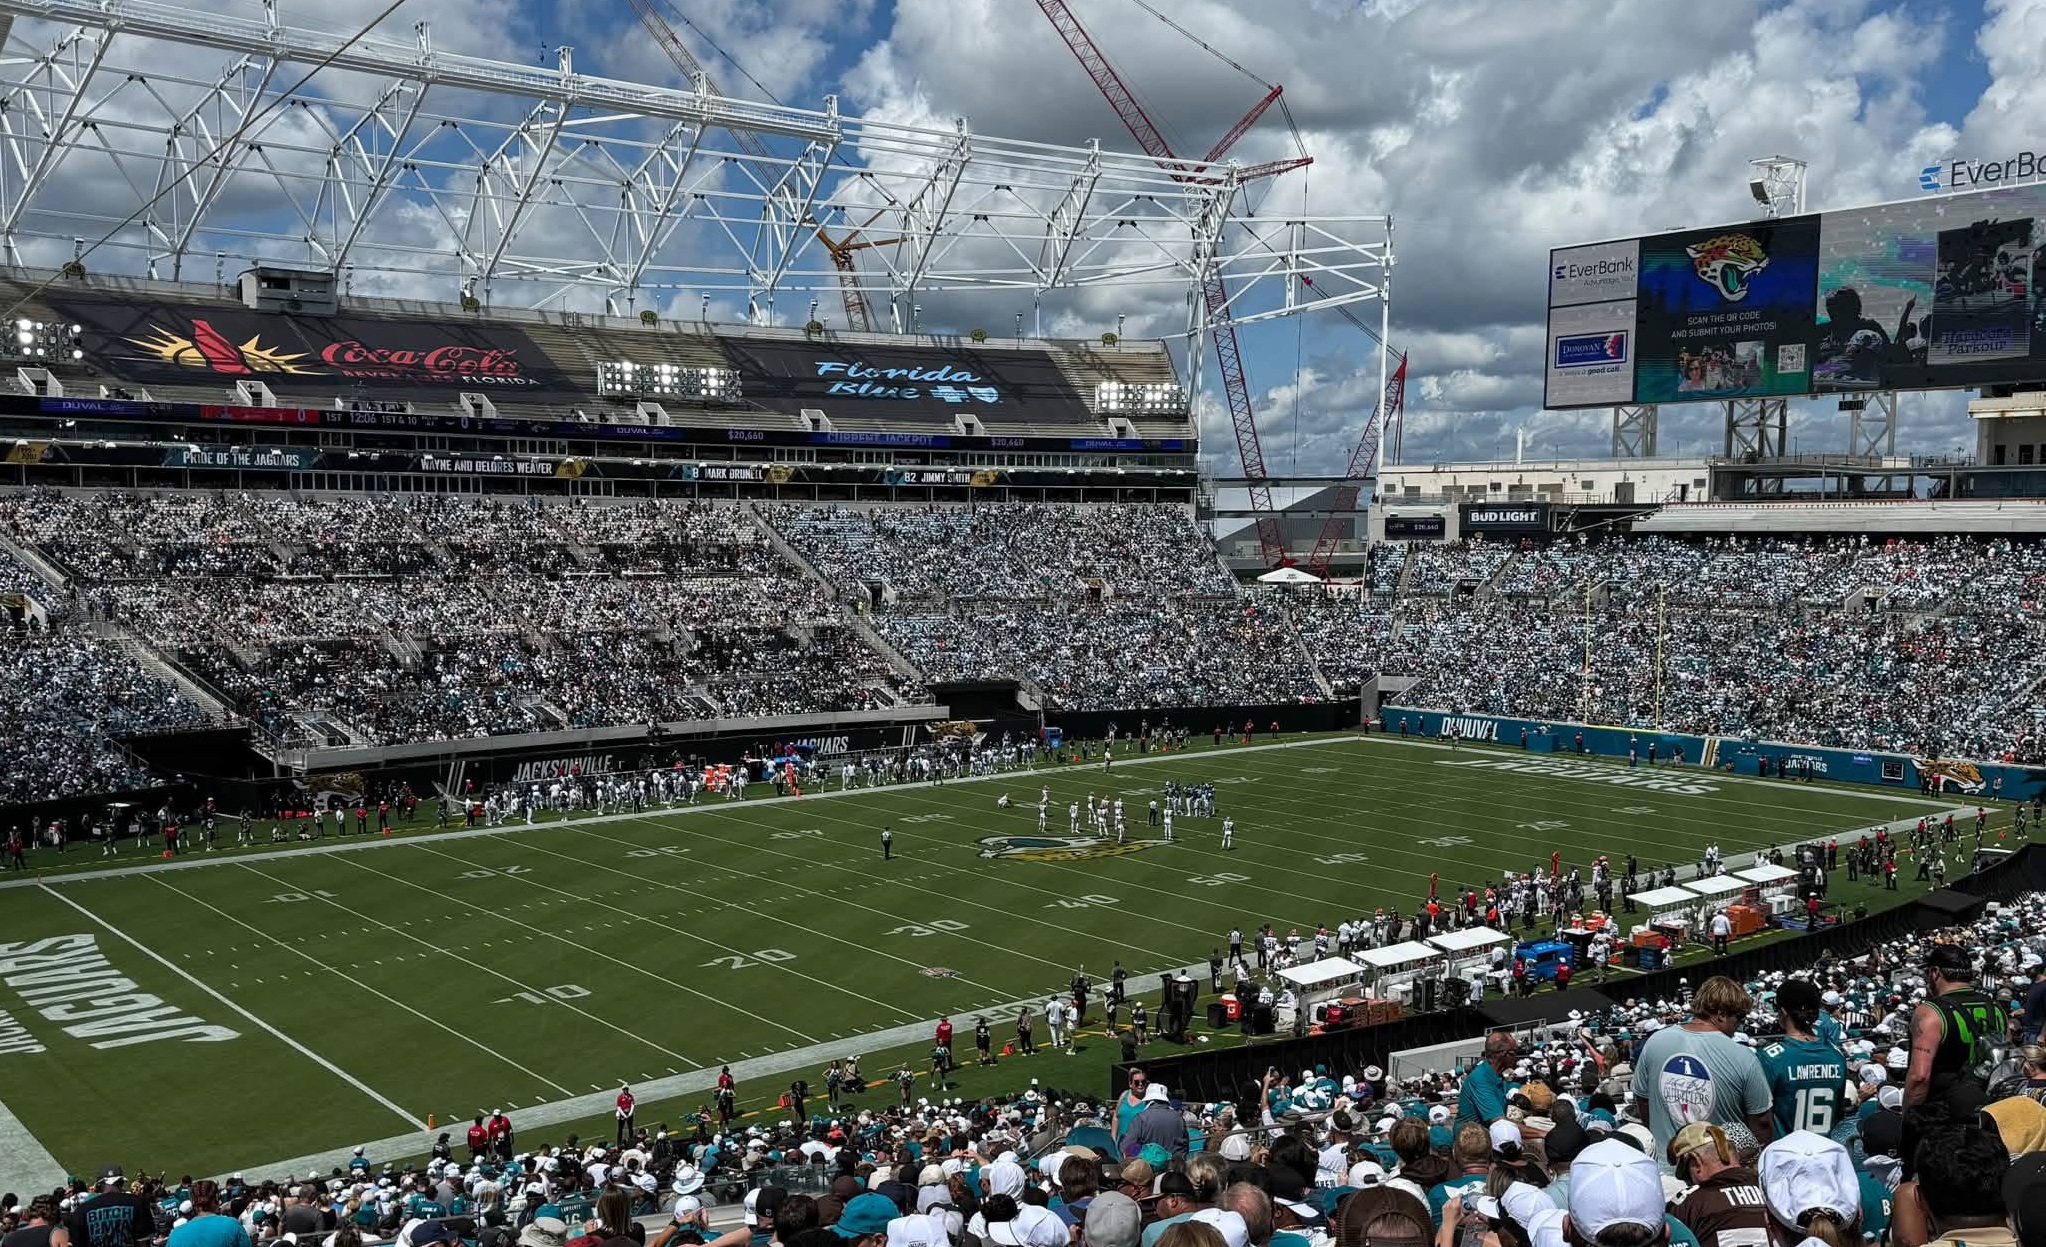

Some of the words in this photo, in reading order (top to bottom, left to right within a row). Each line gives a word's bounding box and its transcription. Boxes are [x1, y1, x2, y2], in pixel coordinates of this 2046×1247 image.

[1569, 257, 1633, 278] EverBank
[1687, 316, 1708, 326] SCAN
[1710, 314, 1725, 323] THE
[1726, 312, 1738, 322] QR
[1740, 311, 1760, 321] CODE
[1671, 330, 1687, 338] AND
[1688, 327, 1717, 337] SUBMIT
[1719, 324, 1741, 334] YOUR
[1743, 321, 1777, 332] PHOTOS!
[1562, 343, 1600, 354] DONOVAN
[321, 340, 518, 376] Coca-Cola
[814, 361, 981, 382] Florida
[1587, 366, 1605, 375] good
[462, 375, 541, 385] FLORIDA
[828, 380, 919, 399] Blue
[62, 400, 104, 411] DUVAL
[326, 412, 342, 422] 1ST
[350, 413, 376, 424] 12:06
[616, 426, 649, 435] DUVAL
[183, 450, 214, 465] PRIDE
[216, 452, 229, 465] OF
[231, 452, 250, 466] THE
[253, 453, 299, 467] JAGUARS
[421, 458, 452, 471] WAYNE
[454, 460, 473, 472] AND
[475, 460, 514, 473] DELORES
[517, 461, 552, 474] WEAVER
[692, 468, 699, 478] 8
[704, 467, 727, 479] MARK
[904, 472, 916, 482] 82
[921, 472, 945, 483] JIMMY
[947, 473, 971, 483] SMITH
[1471, 511, 1498, 522] BUD
[1500, 511, 1537, 522] LIGHT
[512, 755, 613, 782] JACKSONVILLE
[1187, 872, 1251, 887] 50
[1056, 894, 1120, 908] 40
[894, 919, 971, 937] 30
[714, 949, 797, 969] 20
[513, 984, 592, 1005] 10
[1763, 1042, 1785, 1058] 16
[1788, 1064, 1841, 1081] LAWRENCE
[1794, 1088, 1834, 1134] 16
